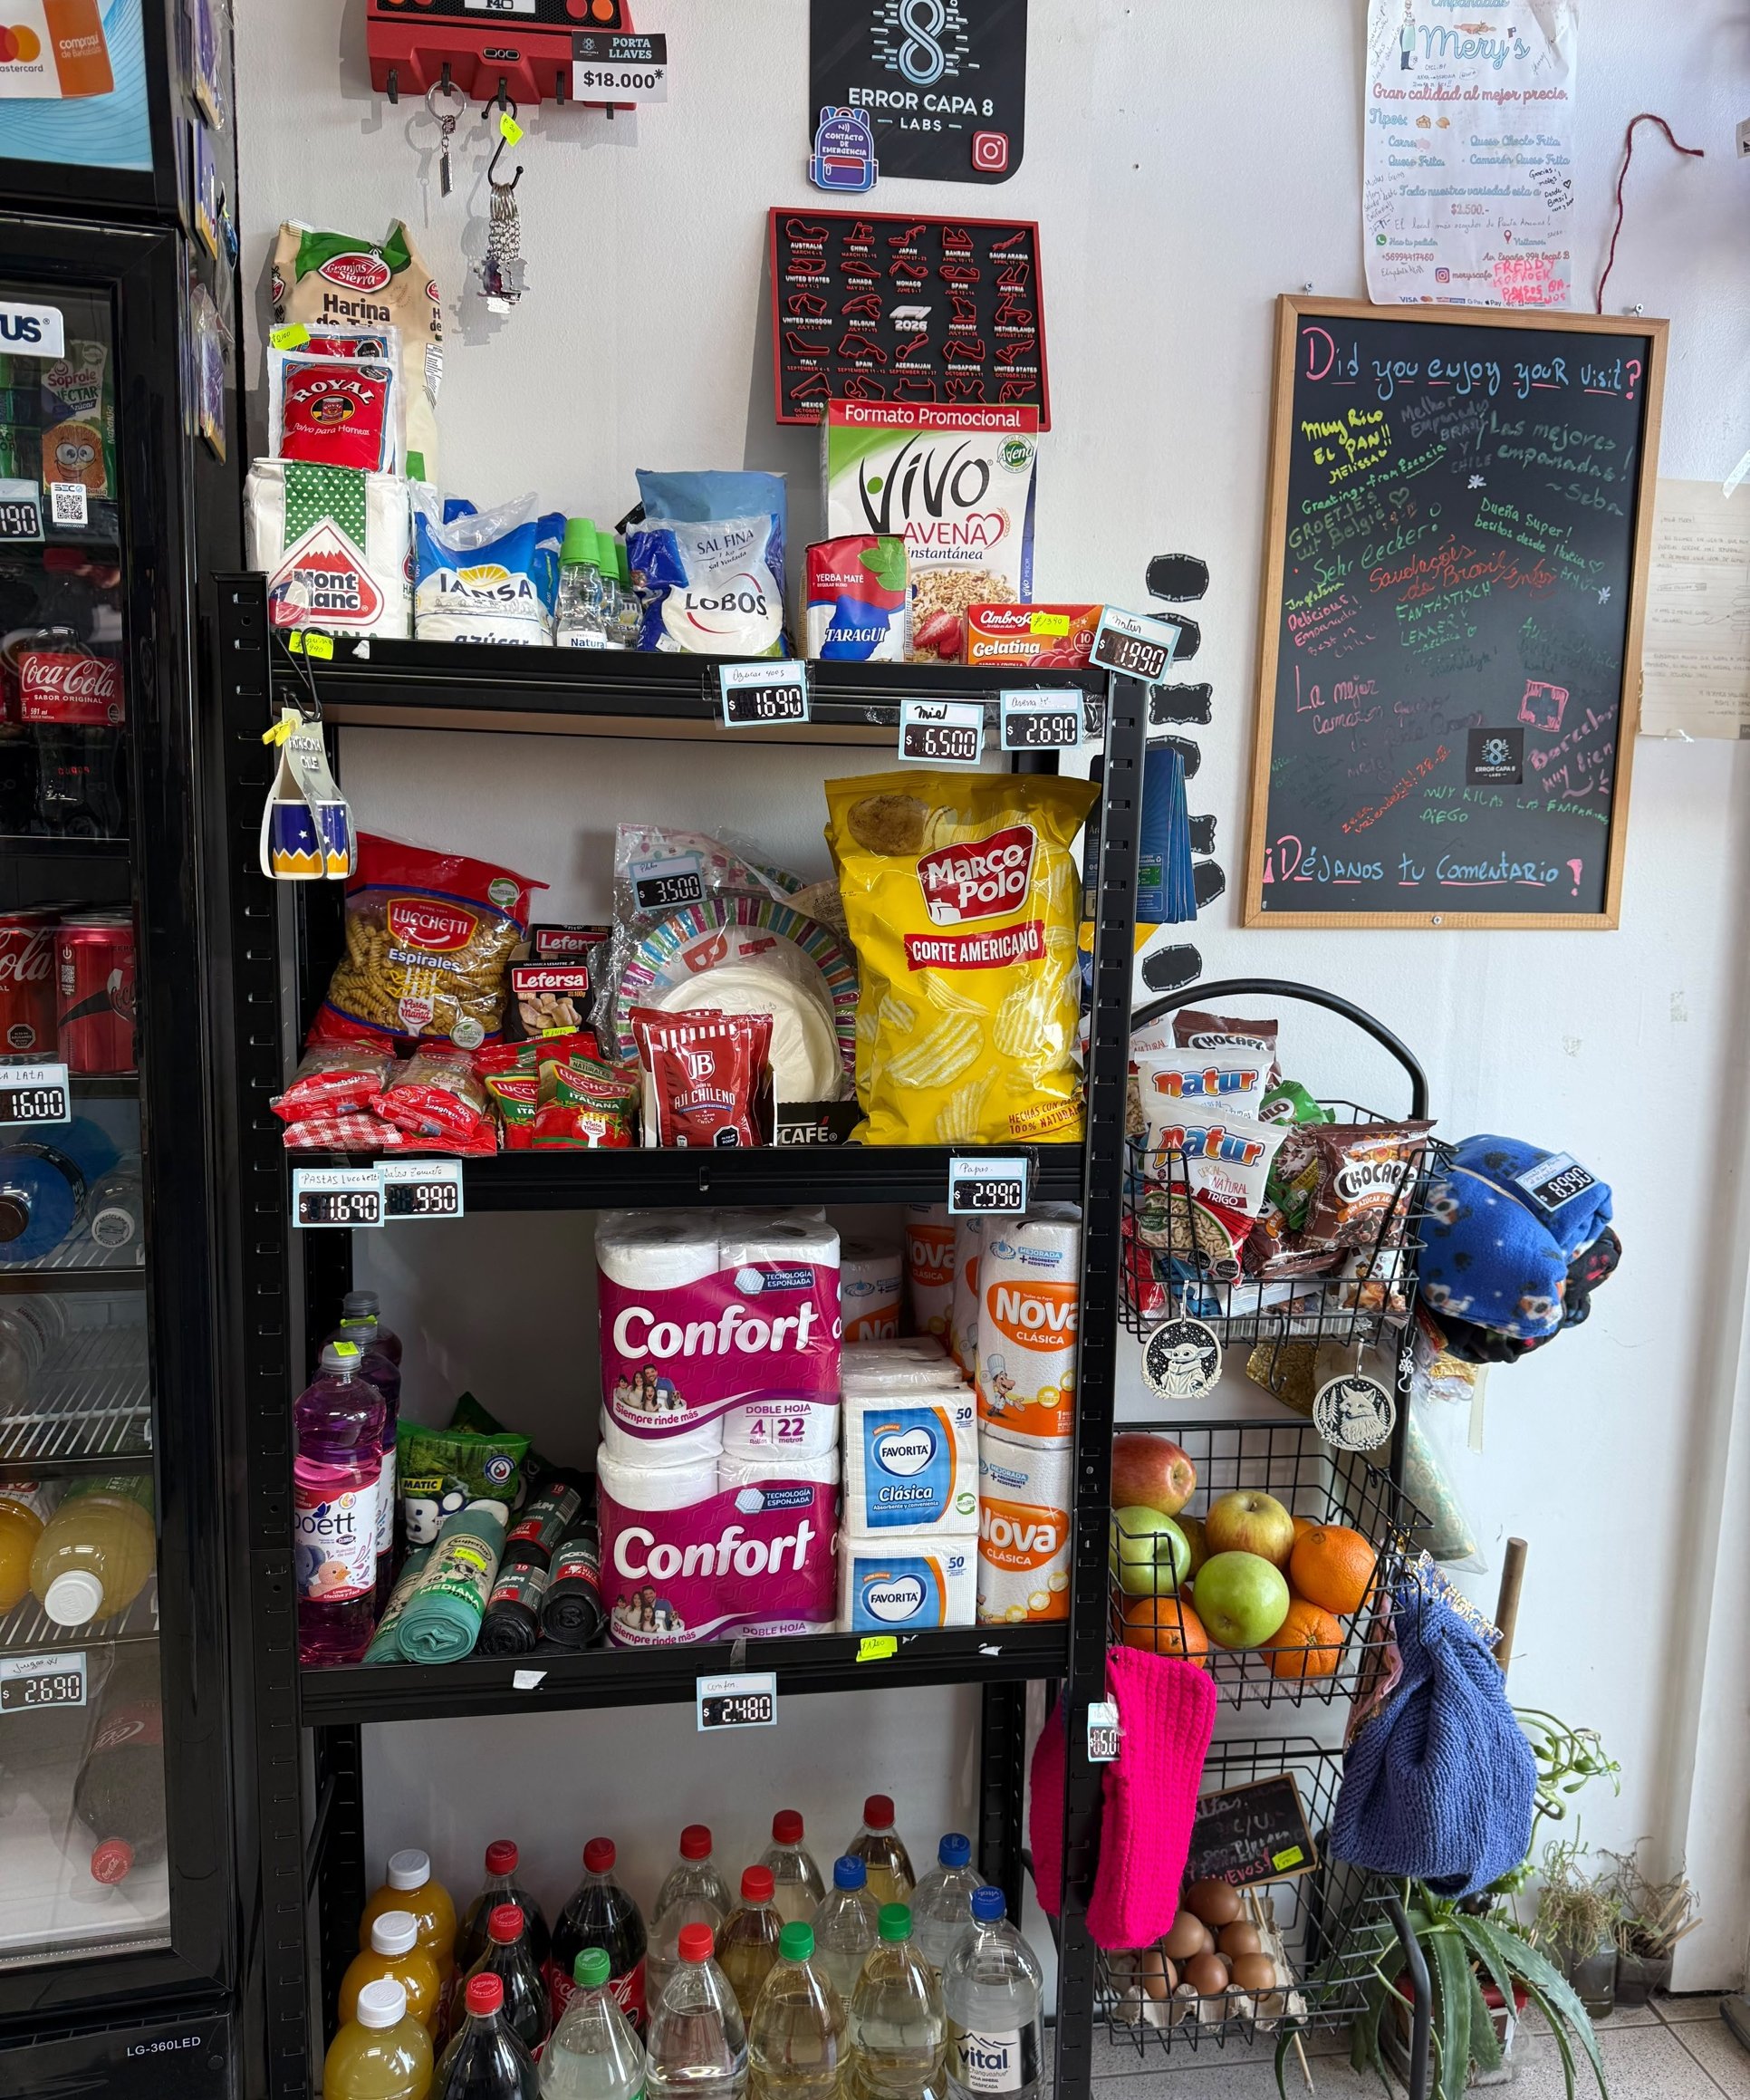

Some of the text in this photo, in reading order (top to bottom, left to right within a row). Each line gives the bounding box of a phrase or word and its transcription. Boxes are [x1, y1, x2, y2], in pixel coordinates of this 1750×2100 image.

[609, 48, 652, 59] LLAVES
[613, 37, 650, 48] PORTA
[848, 88, 995, 116] ERROR CAPA 8
[1372, 82, 1407, 101] Gran
[1409, 84, 1462, 101] calidad
[1463, 84, 1480, 101] al
[1481, 89, 1522, 106] mejor
[899, 117, 942, 132] LABS
[1369, 108, 1408, 130] Tipos:
[824, 132, 864, 142] CONTACTO
[822, 146, 867, 156] EMERGENCIA
[1466, 185, 1511, 197] variedad
[850, 245, 869, 253] CHINA
[326, 262, 367, 274] Granjas
[337, 271, 376, 285] Sierra
[784, 275, 807, 283] UNITED
[896, 280, 922, 288] MONACO
[323, 293, 390, 323] Harina
[895, 320, 928, 332] 2026
[994, 325, 1035, 333] NETHERLANDS
[1302, 326, 1360, 381] Did
[1371, 361, 1419, 401] you
[48, 369, 97, 389] Soprole
[292, 379, 375, 405] ROYAL
[844, 404, 914, 424] Formato
[918, 407, 1021, 428] Promocional
[293, 422, 315, 435] Polvo
[316, 427, 336, 436] para
[1480, 496, 1520, 523] Dueña
[697, 528, 755, 555] SAL FINA
[905, 521, 987, 545] AVENA
[1516, 533, 1546, 554] desde
[907, 546, 983, 561] instantánea
[816, 573, 842, 583] YERBA
[685, 592, 768, 616] LOBOS
[972, 639, 1041, 658] Gelatina
[1119, 641, 1167, 676] 1.990
[22, 656, 116, 698] Coca-Cola
[62, 695, 103, 704] ORIGINAL
[755, 688, 802, 718] 1.690
[1025, 716, 1075, 744] 2.690
[925, 727, 976, 757] 6.500
[655, 875, 700, 903] 3.500
[392, 907, 469, 935] LUCCHETTI
[912, 927, 1039, 963] CORTE AMERICANO
[389, 948, 461, 972] Espirales
[517, 972, 584, 988] Lefersa
[689, 1053, 713, 1080] JB
[1154, 1068, 1256, 1099] natur
[12, 1089, 63, 1119] 1.600
[569, 1092, 620, 1110] ITALIANA
[674, 1088, 736, 1110] AJÍ CHILENO
[1008, 1102, 1058, 1124] HECHAS CON
[1009, 1122, 1037, 1134] 100%
[972, 1182, 1021, 1208] 2.990
[1207, 1190, 1239, 1207] TRIGO
[329, 1194, 378, 1221] 1.690
[765, 1270, 812, 1281] TECNOLOGÍA
[995, 1286, 1080, 1332] Nova
[612, 1301, 819, 1360] Confort
[1015, 1331, 1065, 1345] CLÁSICA
[615, 1402, 699, 1426] Siempre rinde más
[745, 1403, 812, 1415] DOBLE HOJA
[777, 1417, 806, 1438] 22
[881, 1444, 928, 1458] FAVORITA
[404, 1479, 438, 1490] MATIC
[879, 1483, 934, 1502] Clásica
[612, 1519, 816, 1581] Confort
[419, 1583, 480, 1610] MEDIANA
[870, 1591, 918, 1604] FAVORITA
[24, 1674, 80, 1703] 2.690
[721, 1696, 771, 1722] 2.480
[126, 2036, 202, 2057] LG-360LED
